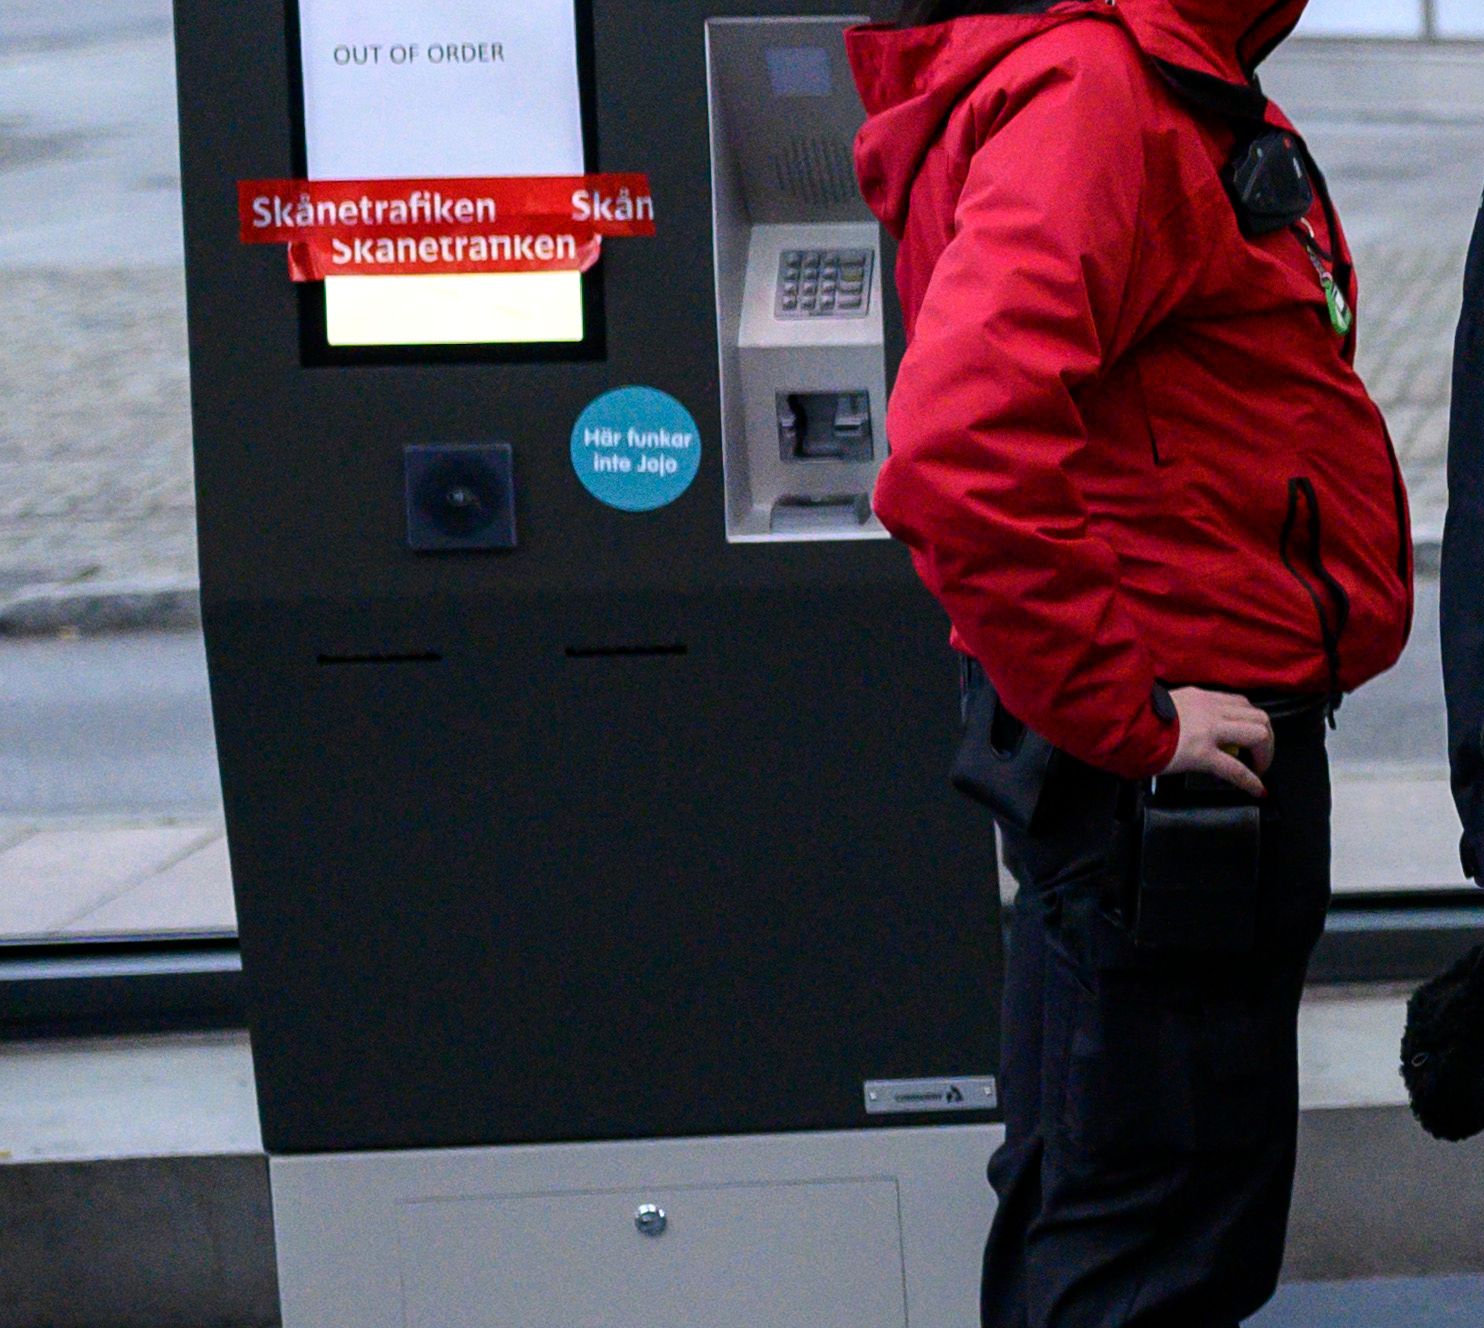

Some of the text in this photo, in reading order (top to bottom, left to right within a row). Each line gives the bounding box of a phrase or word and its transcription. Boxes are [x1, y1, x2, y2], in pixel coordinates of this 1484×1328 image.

[332, 42, 505, 64] OUT OF ORDER
[252, 189, 655, 228] Skånetrafiken Skån
[584, 426, 693, 449] Här funkar
[593, 452, 679, 478] inte Jojo
